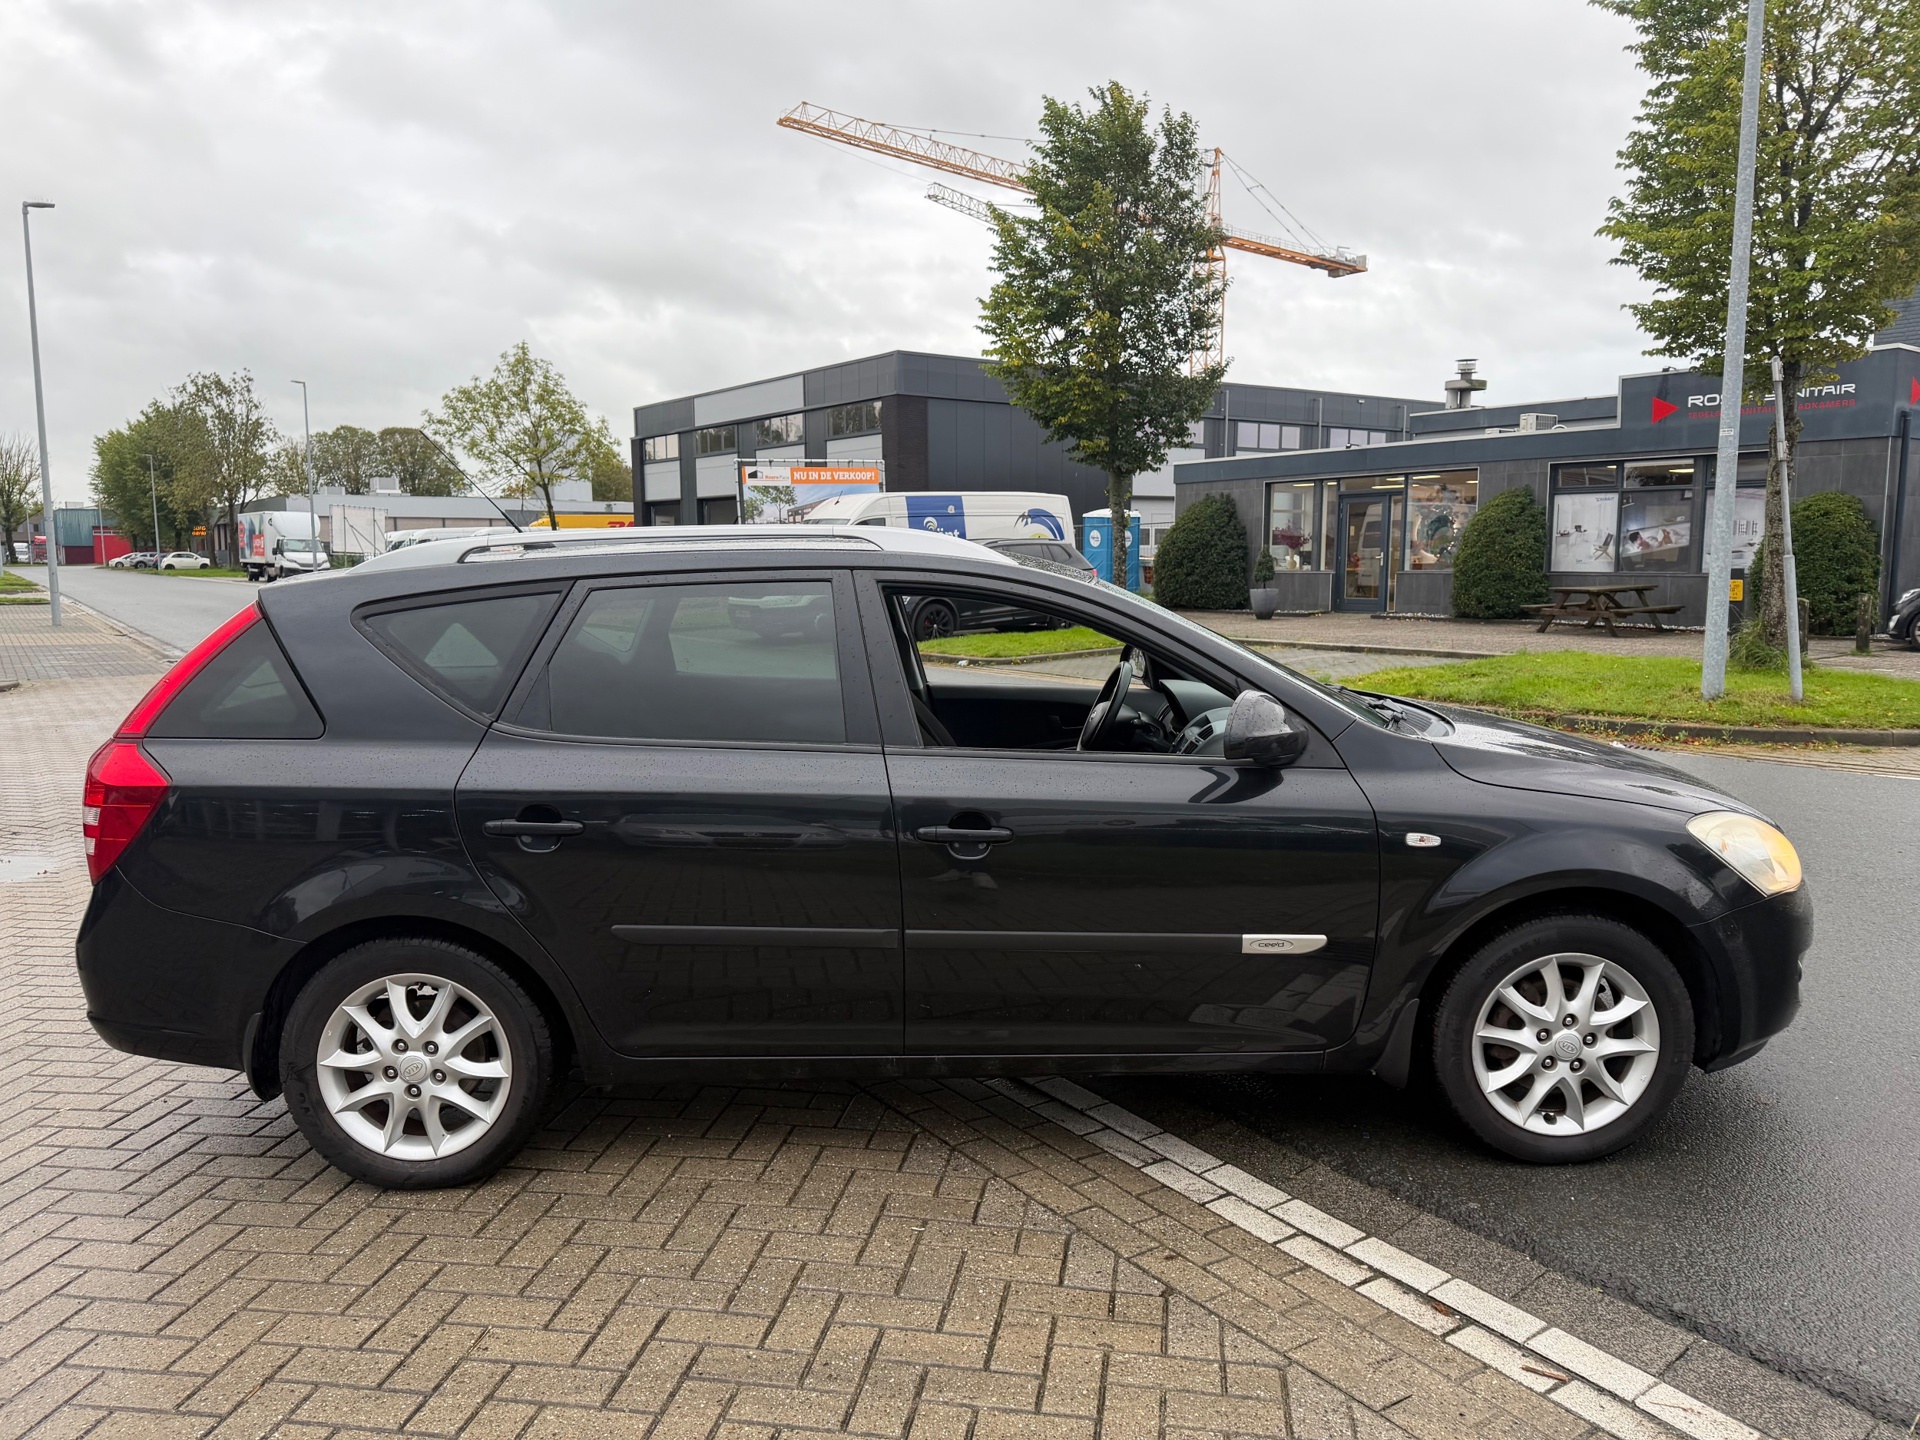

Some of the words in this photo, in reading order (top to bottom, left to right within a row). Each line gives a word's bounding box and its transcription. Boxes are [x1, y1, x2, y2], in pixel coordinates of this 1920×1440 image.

[1740, 405, 1777, 416] ANITAIR
[1798, 399, 1856, 411] ADKAMERS
[793, 471, 805, 480] NU
[809, 471, 819, 480] IN
[820, 471, 832, 480] DE
[833, 471, 875, 480] VERKOOP!
[405, 1063, 420, 1075] KIA
